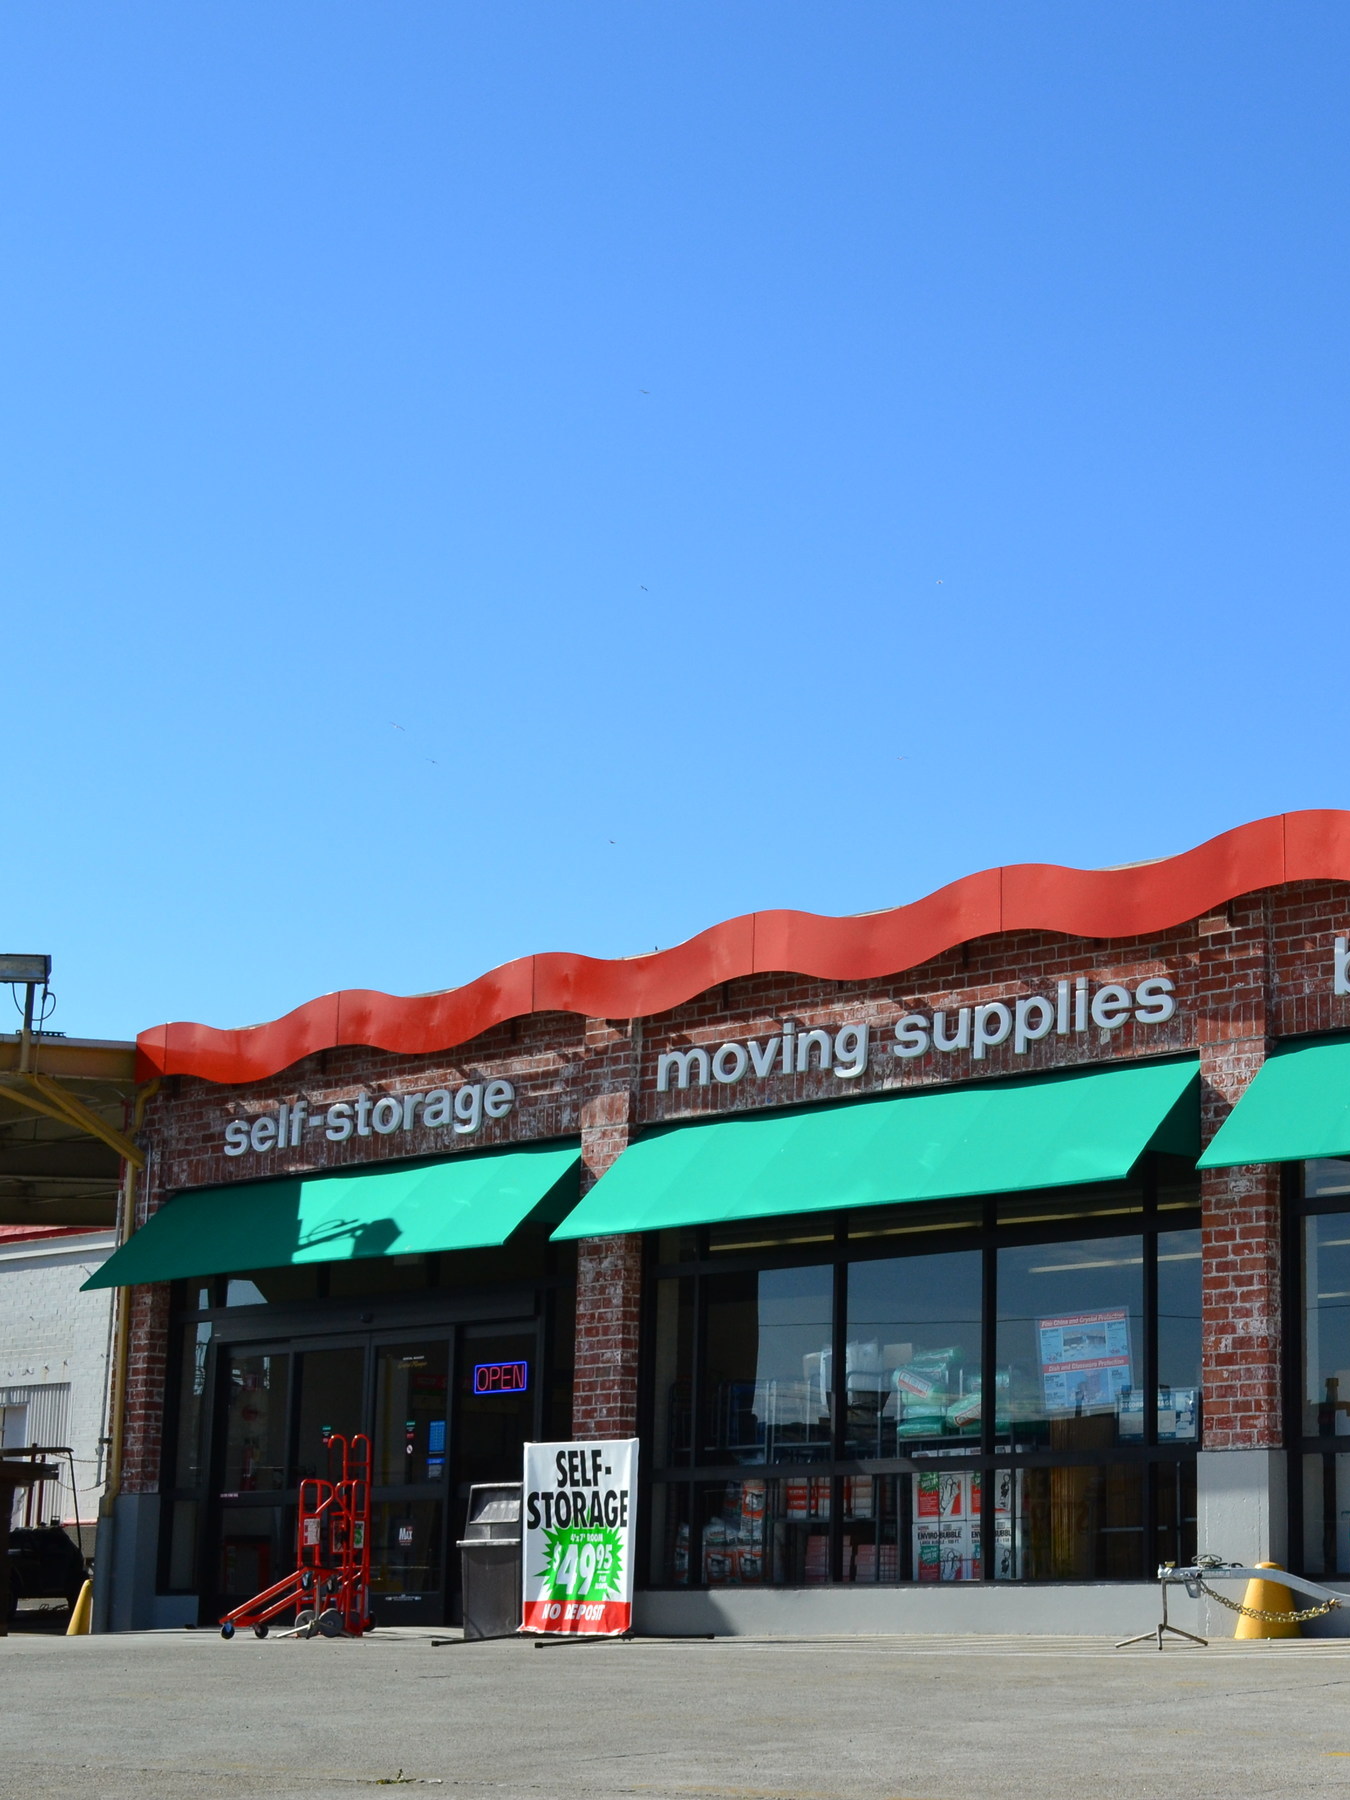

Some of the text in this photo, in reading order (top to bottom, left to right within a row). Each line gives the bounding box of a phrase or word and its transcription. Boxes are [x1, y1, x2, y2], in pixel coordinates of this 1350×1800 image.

[656, 976, 1178, 1093] moving supplies
[223, 1079, 516, 1157] self-storage
[477, 1364, 525, 1391] OPEN
[555, 1449, 612, 1488] SELF-
[527, 1489, 628, 1530] STORAGE
[541, 1602, 605, 1621] NO DEPOSIT
